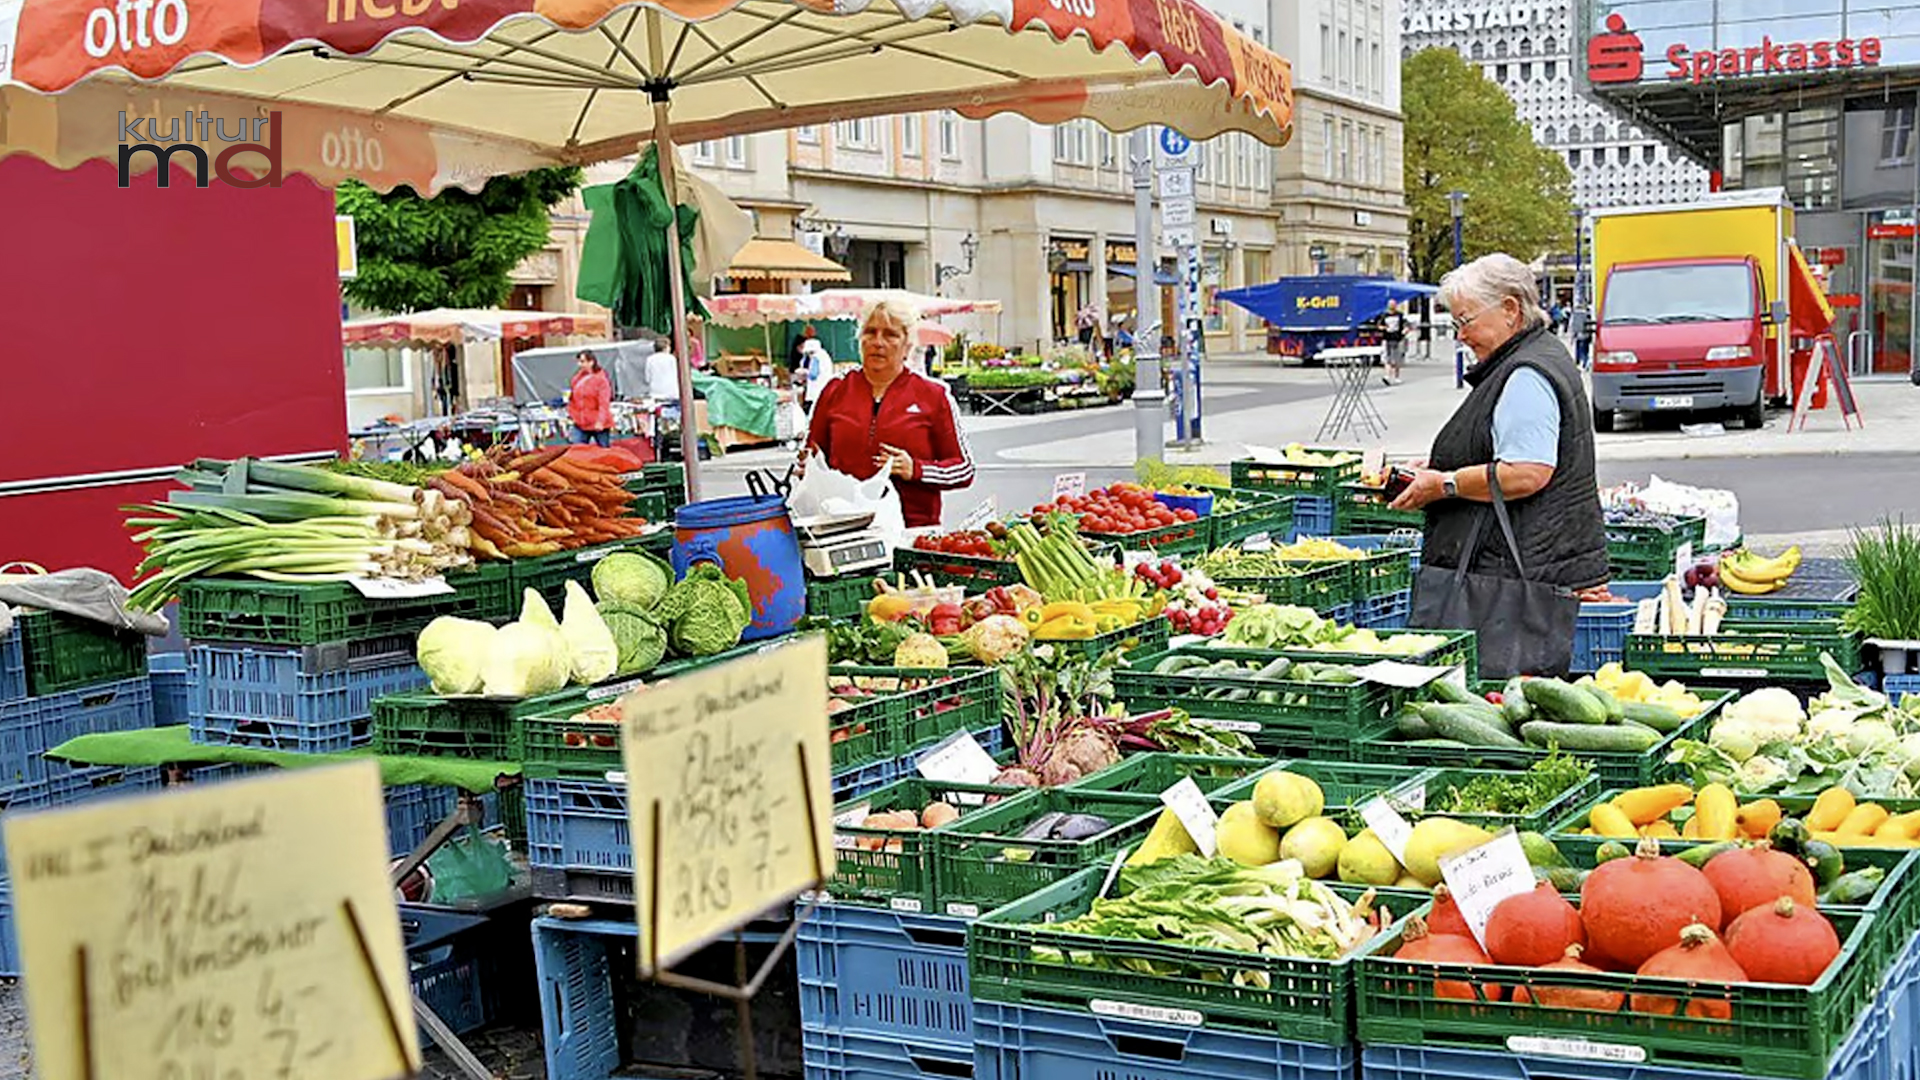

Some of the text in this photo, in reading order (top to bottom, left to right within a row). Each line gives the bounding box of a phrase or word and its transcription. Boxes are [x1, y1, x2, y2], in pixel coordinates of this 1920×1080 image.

[84, 0, 189, 58] otto
[1665, 35, 1882, 85] Sparkasse
[1295, 296, 1340, 309] K-Grill
